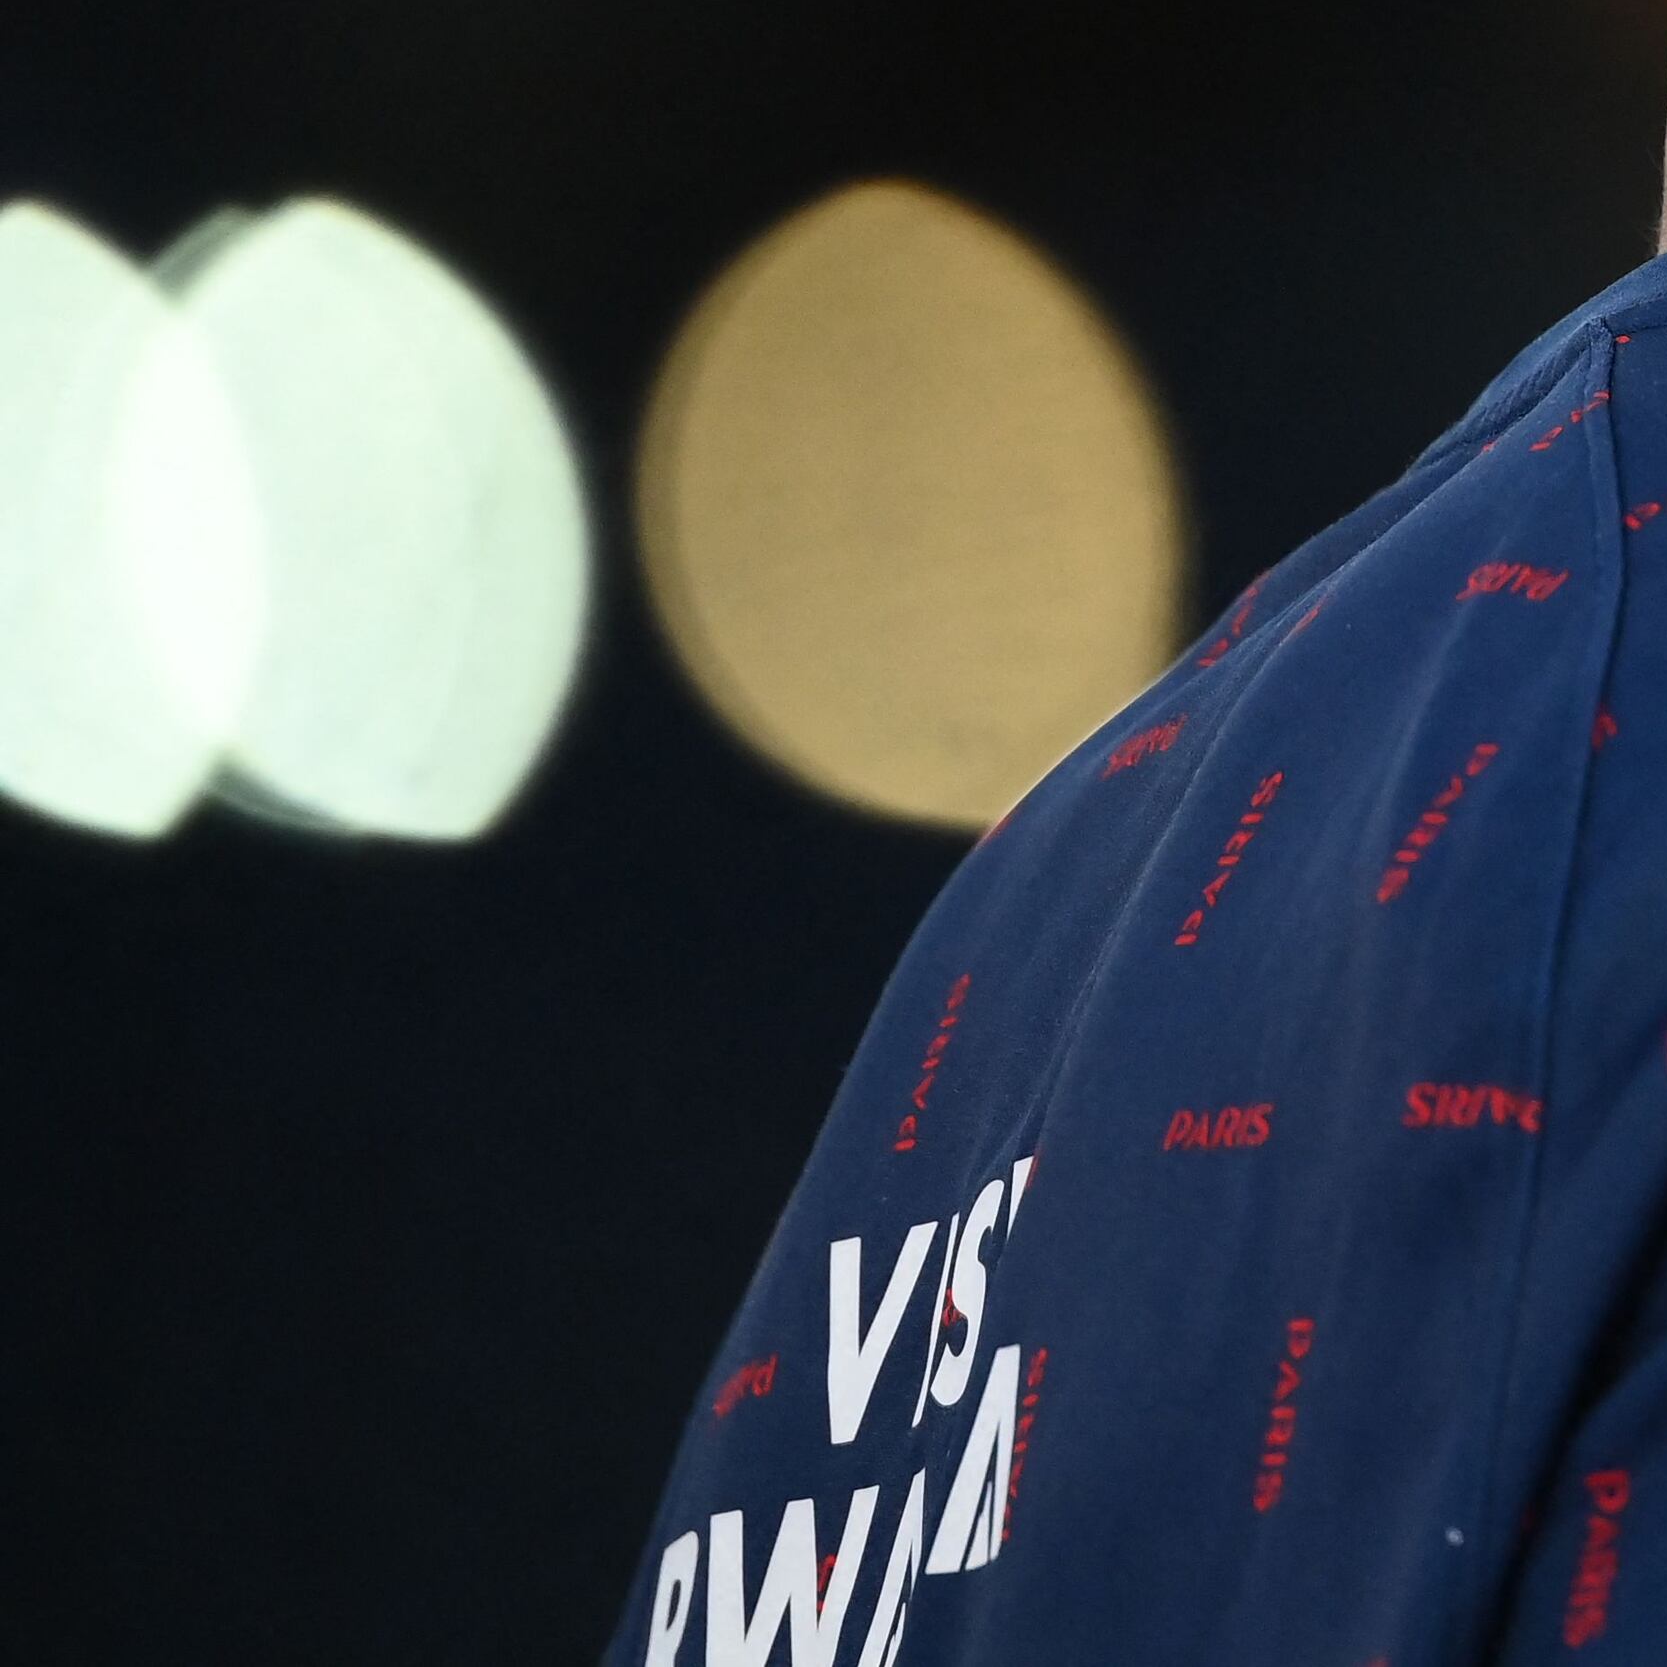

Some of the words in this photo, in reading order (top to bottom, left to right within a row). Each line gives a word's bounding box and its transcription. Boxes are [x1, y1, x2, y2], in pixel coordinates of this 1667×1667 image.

[1174, 771, 1285, 947] PARIS
[894, 972, 972, 1152] PARIS
[1163, 1102, 1275, 1151] PARIS
[1252, 1316, 1316, 1514] PARIS
